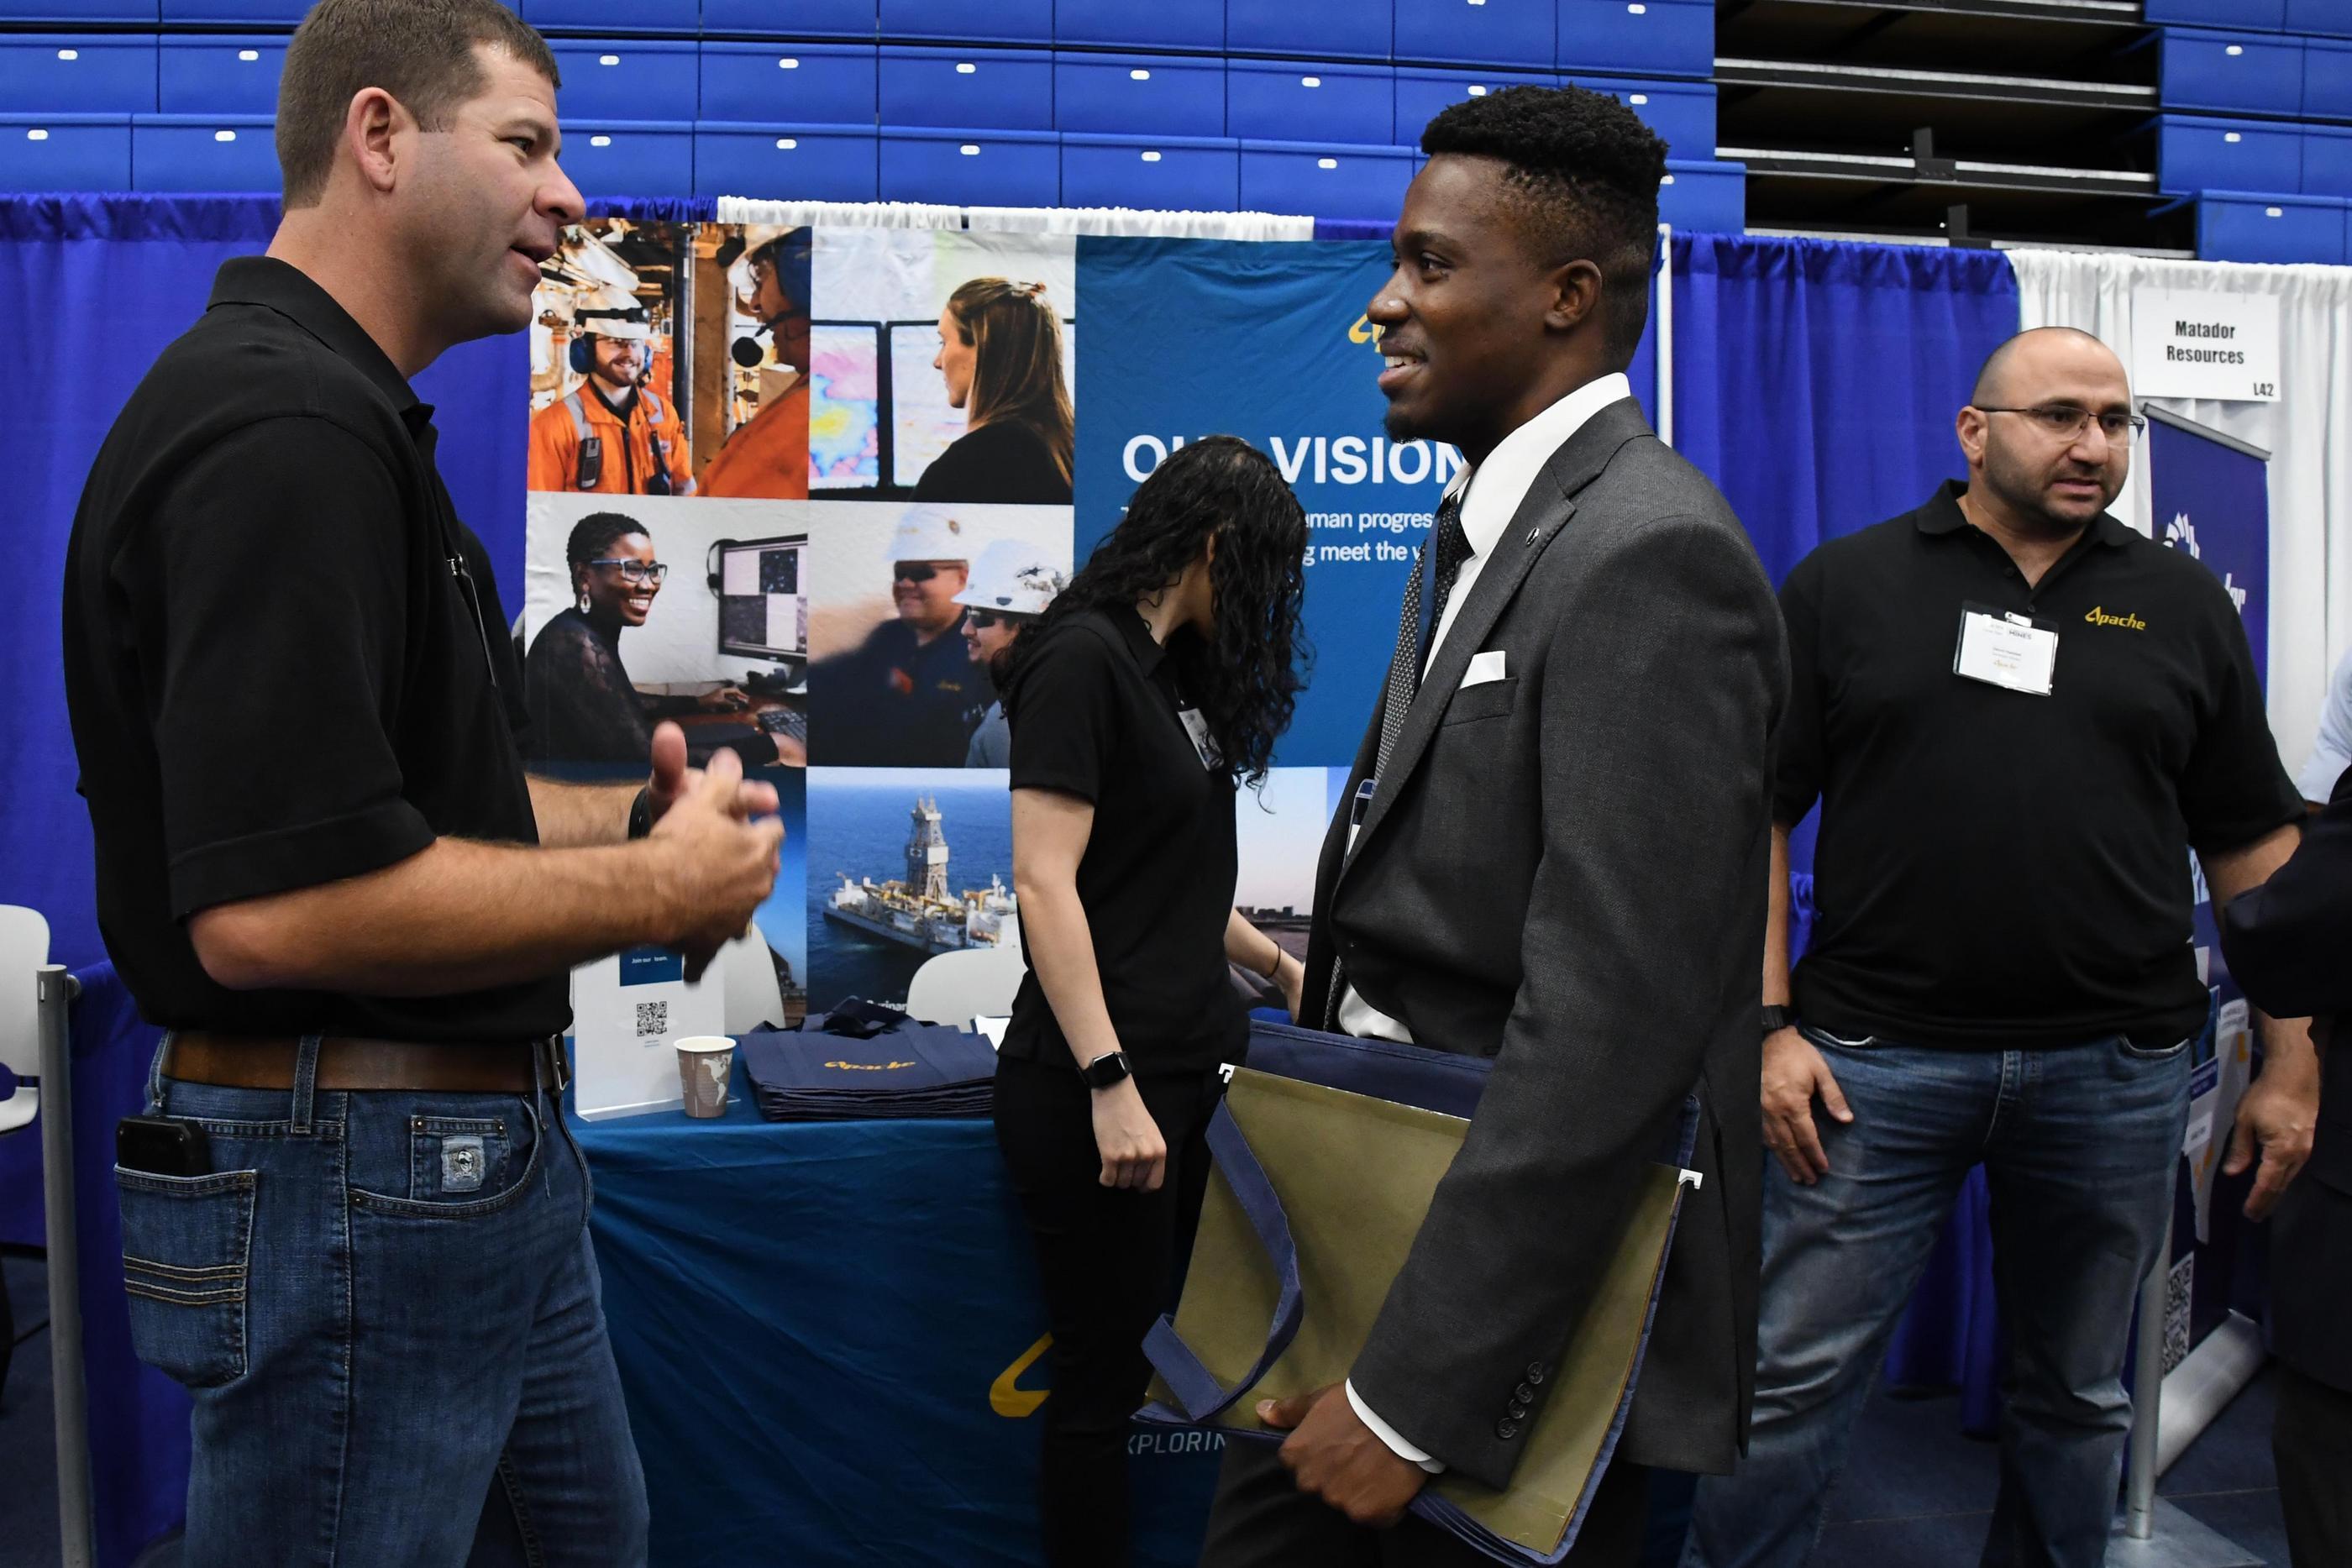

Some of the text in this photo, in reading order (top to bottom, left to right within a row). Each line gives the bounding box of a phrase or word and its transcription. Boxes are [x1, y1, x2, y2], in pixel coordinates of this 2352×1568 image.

[2175, 320, 2235, 339] Matador
[2166, 344, 2244, 364] Resources
[2253, 382, 2274, 396] L42
[1358, 512, 1435, 533] progres
[1320, 542, 1372, 562] meet
[1375, 540, 1409, 562] the
[2084, 605, 2147, 632] Apache
